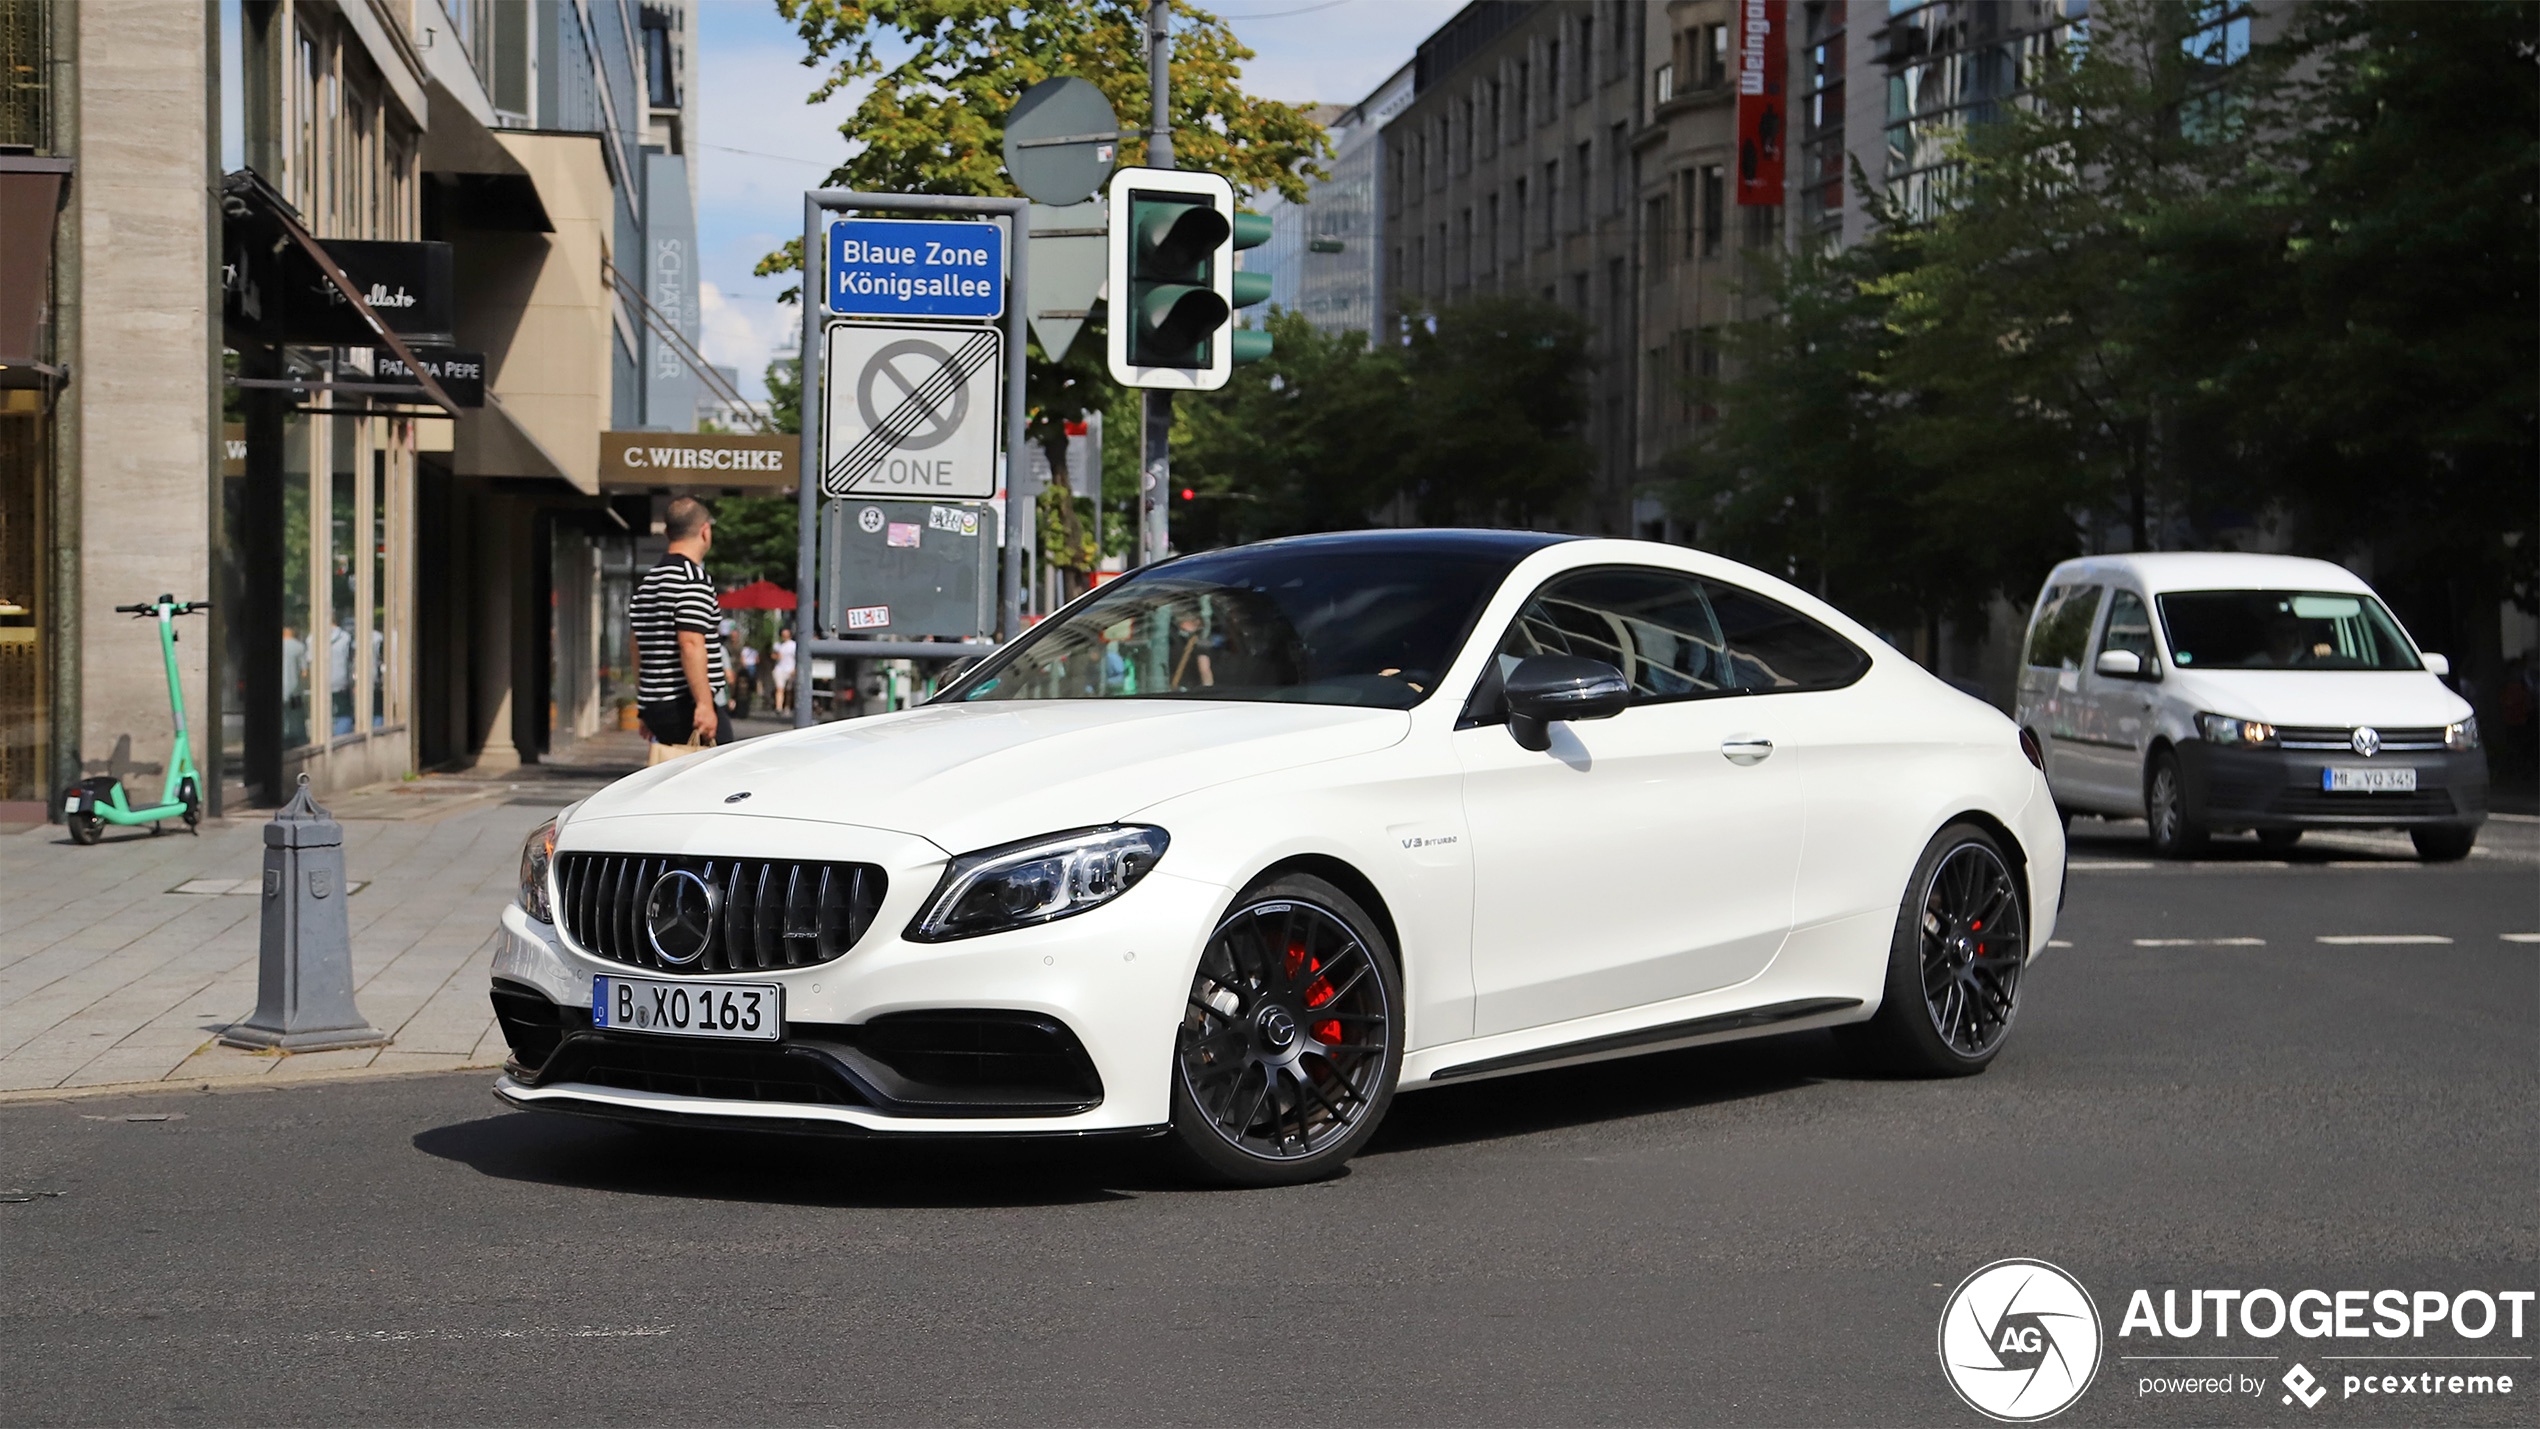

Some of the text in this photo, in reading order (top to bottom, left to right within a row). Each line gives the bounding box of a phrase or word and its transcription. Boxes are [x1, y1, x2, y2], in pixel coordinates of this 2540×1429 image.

[843, 240, 989, 266] Blaue Zone
[839, 270, 992, 302] Königsallee
[444, 361, 480, 380] PEPE
[871, 460, 953, 486] ZONE
[618, 984, 761, 1032] B XO 163
